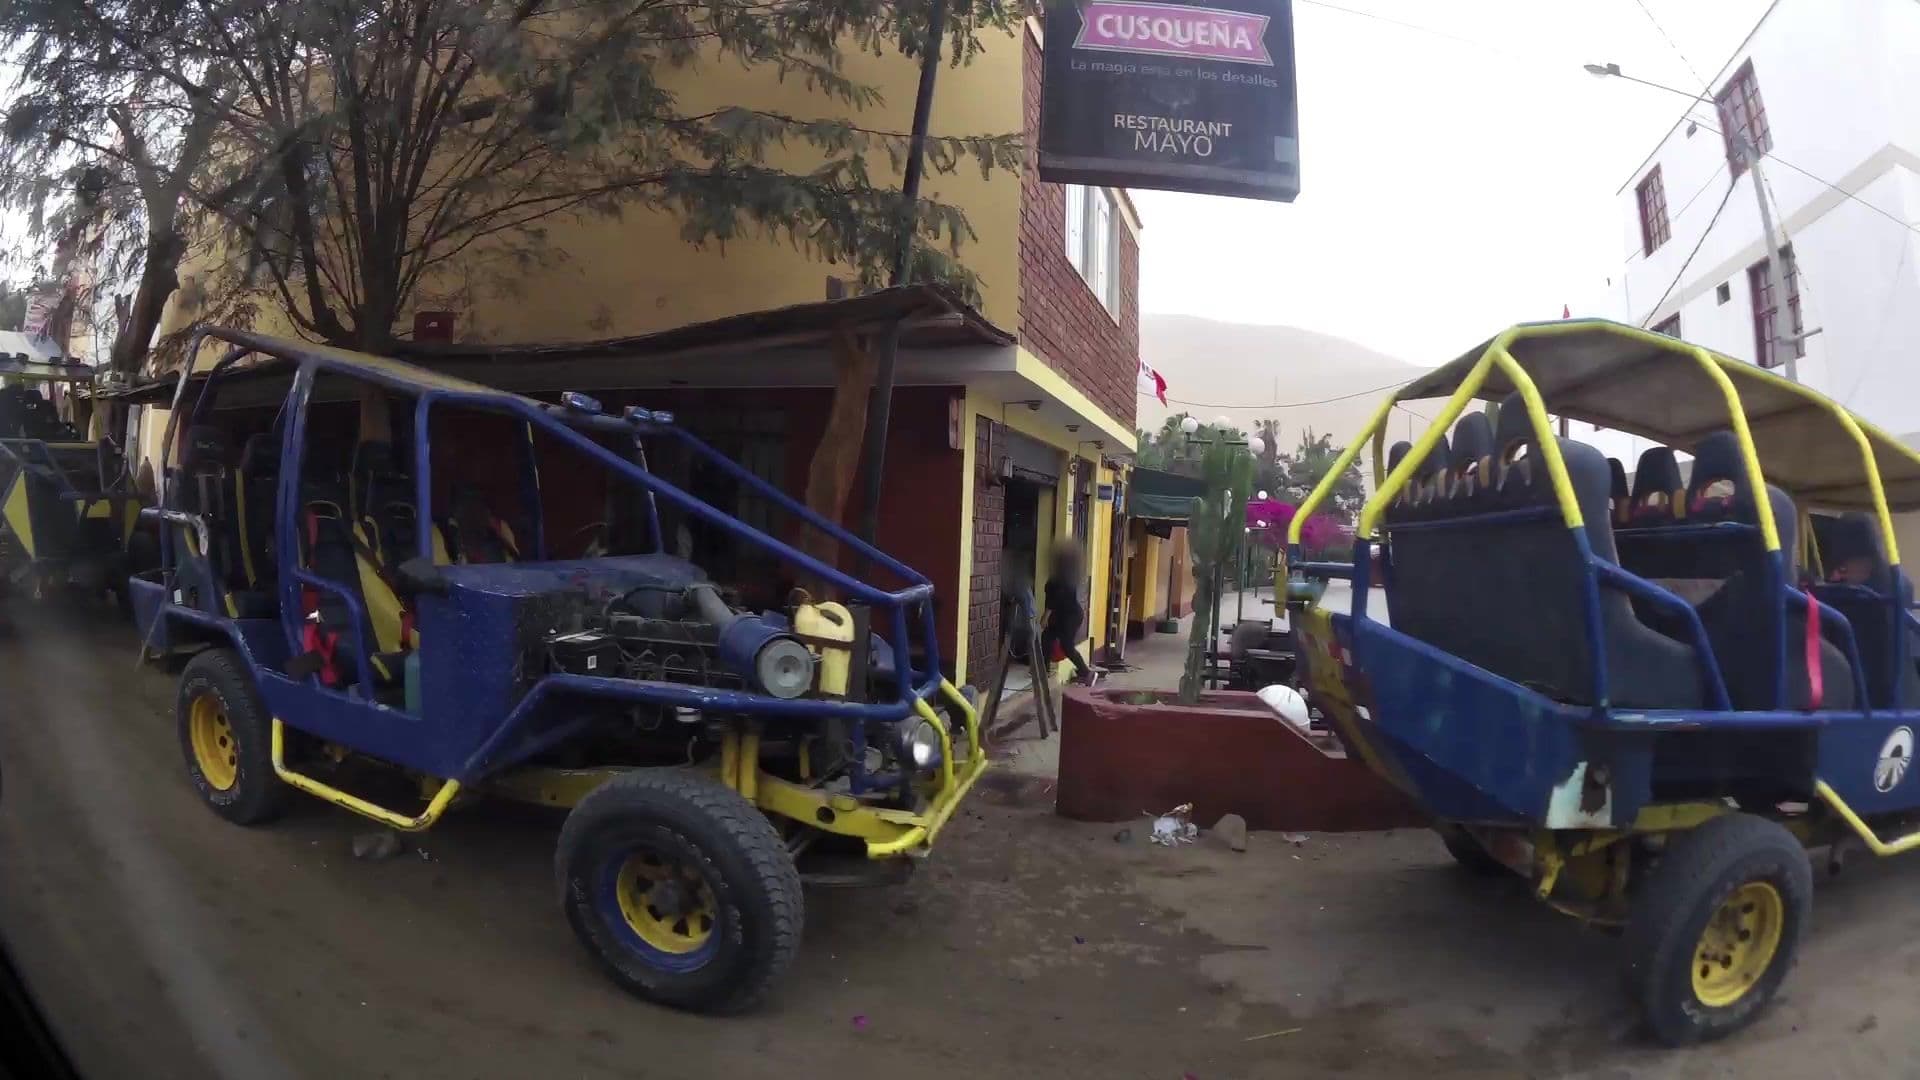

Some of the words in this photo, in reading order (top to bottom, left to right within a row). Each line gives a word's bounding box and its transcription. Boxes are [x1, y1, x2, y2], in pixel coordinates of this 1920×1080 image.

[1097, 14, 1253, 50] CUSQUEÑA
[1070, 58, 1087, 71] La
[1091, 62, 1136, 75] magia
[1141, 65, 1171, 77] ea
[1175, 68, 1193, 79] en
[1197, 67, 1217, 81] los
[1222, 69, 1280, 88] detalles
[1114, 114, 1233, 137] RESTAURANT
[1134, 130, 1212, 157] MAYO
